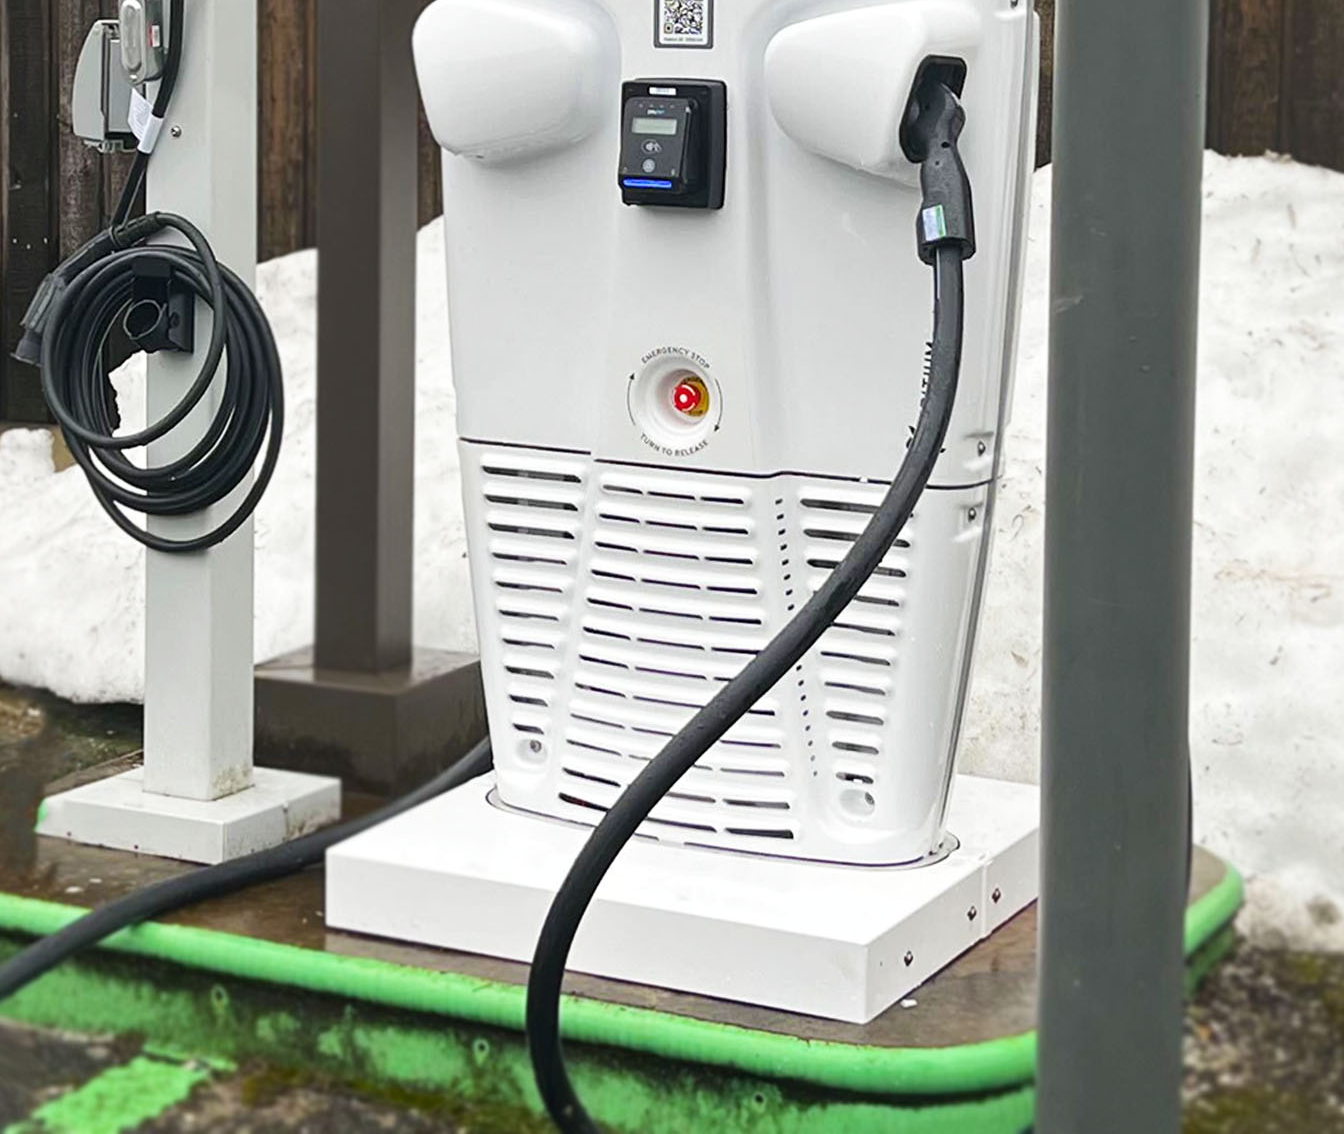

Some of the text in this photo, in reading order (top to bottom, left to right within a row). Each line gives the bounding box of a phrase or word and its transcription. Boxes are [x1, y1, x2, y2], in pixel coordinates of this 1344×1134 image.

[641, 346, 711, 369] EMERGENCY STOP
[640, 432, 709, 457] TURN TO RELEASE
